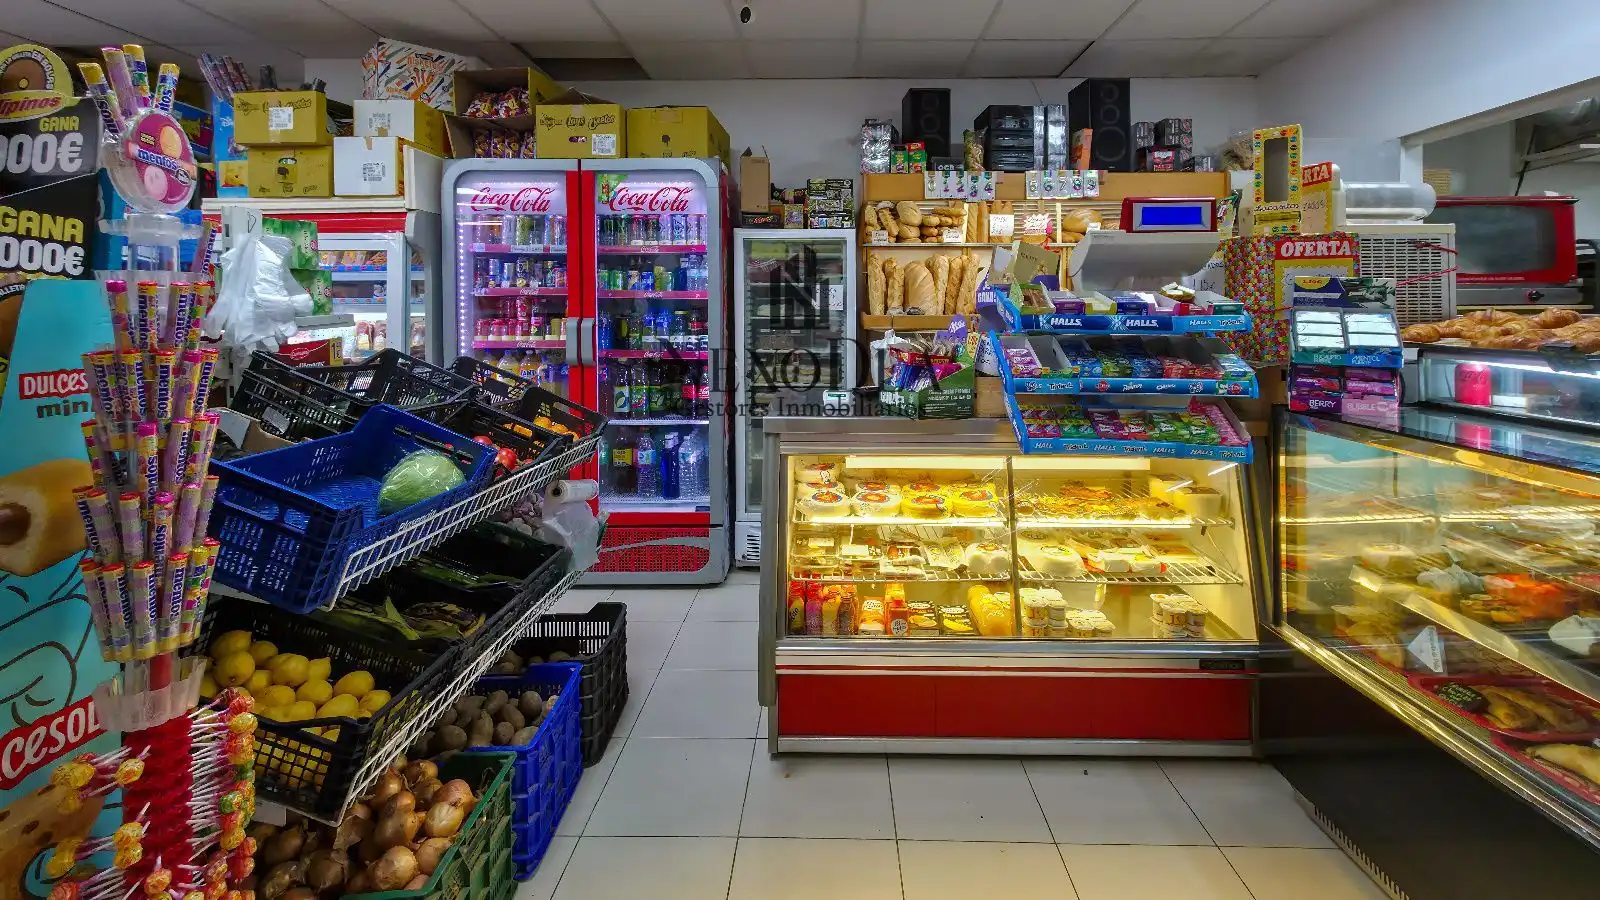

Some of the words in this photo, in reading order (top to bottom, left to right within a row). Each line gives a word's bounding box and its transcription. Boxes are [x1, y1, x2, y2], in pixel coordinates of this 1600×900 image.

[39, 116, 80, 131] GANA
[138, 149, 178, 171] mentos
[1302, 165, 1329, 183] RTA
[470, 186, 555, 212] Coca-Cola
[609, 186, 693, 212] Coca-Cola
[0, 205, 84, 244] GANA
[1281, 240, 1351, 258] OFERTA
[1050, 317, 1083, 327] HALLS
[1126, 318, 1159, 327] HALLS
[36, 399, 95, 420] min
[1308, 399, 1337, 408] BERRY
[169, 567, 186, 621] mentos
